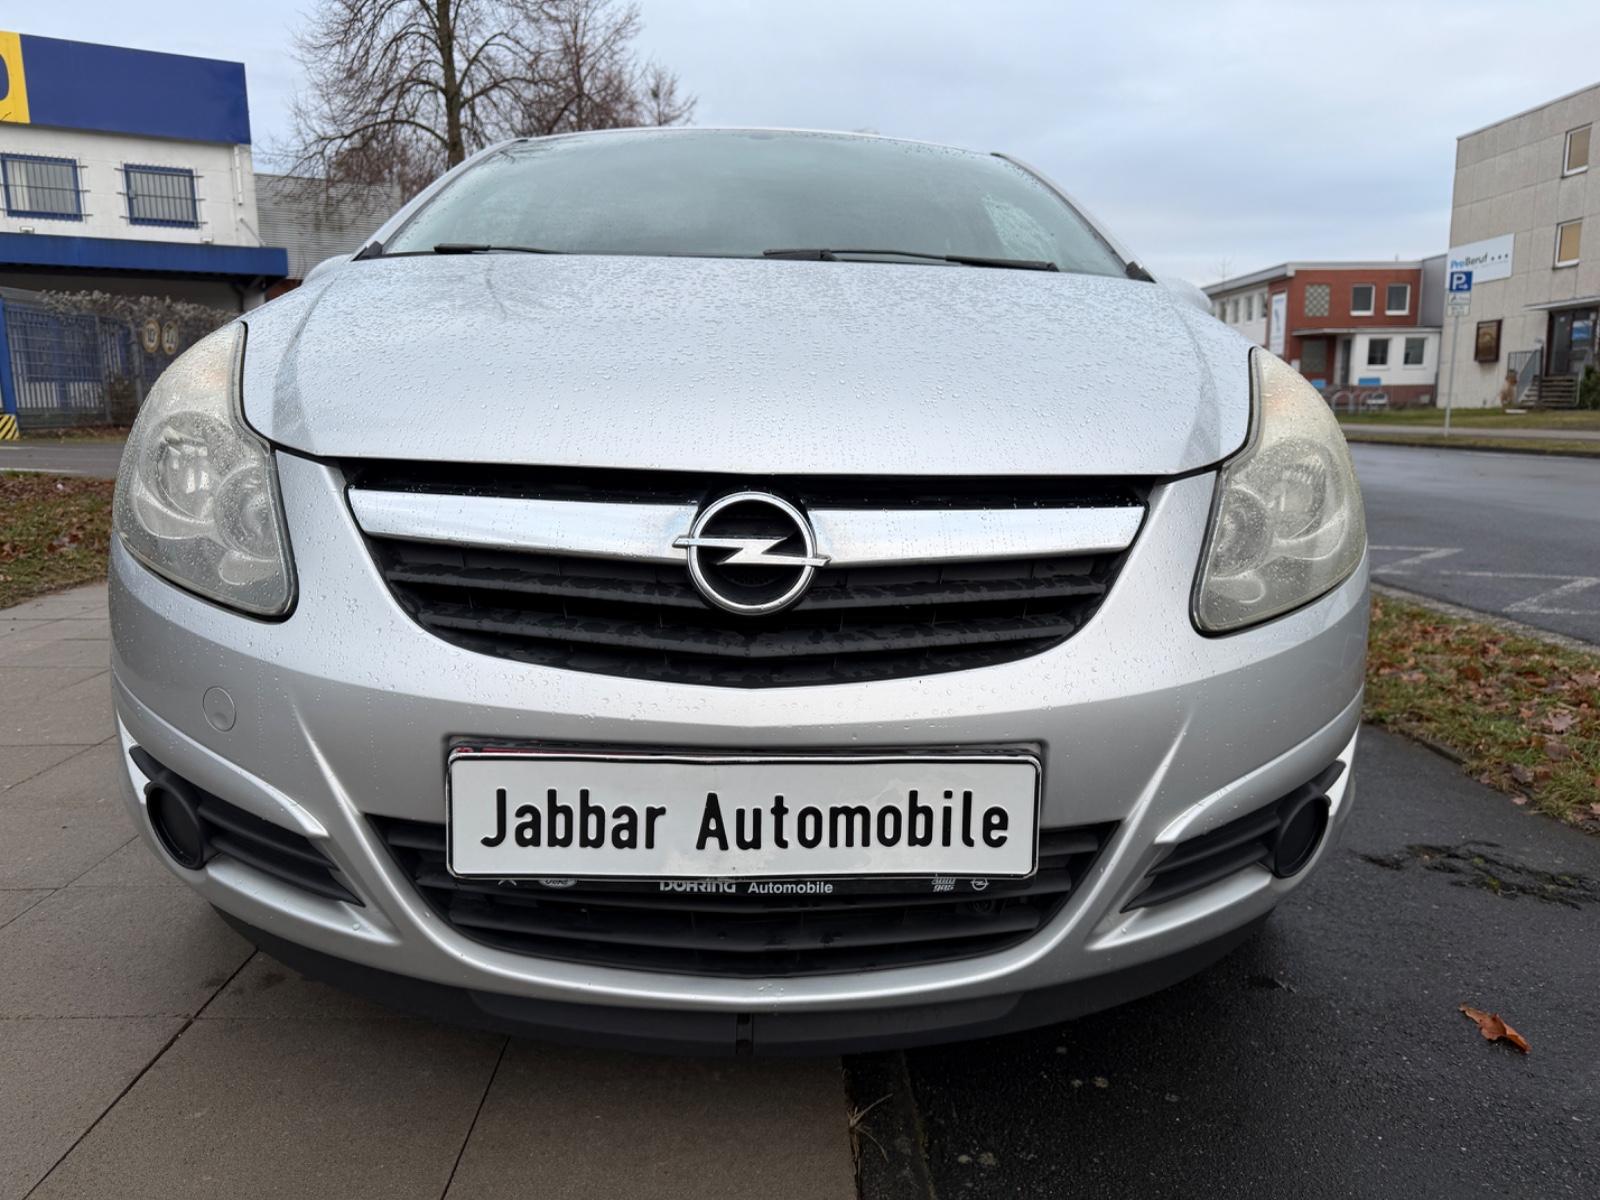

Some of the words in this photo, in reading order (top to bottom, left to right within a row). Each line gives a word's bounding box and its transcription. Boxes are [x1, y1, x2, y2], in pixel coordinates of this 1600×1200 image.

[1452, 273, 1466, 290] P
[480, 788, 667, 849] Jabbar
[695, 789, 1009, 851] Automobile
[747, 882, 833, 894] Automobile
